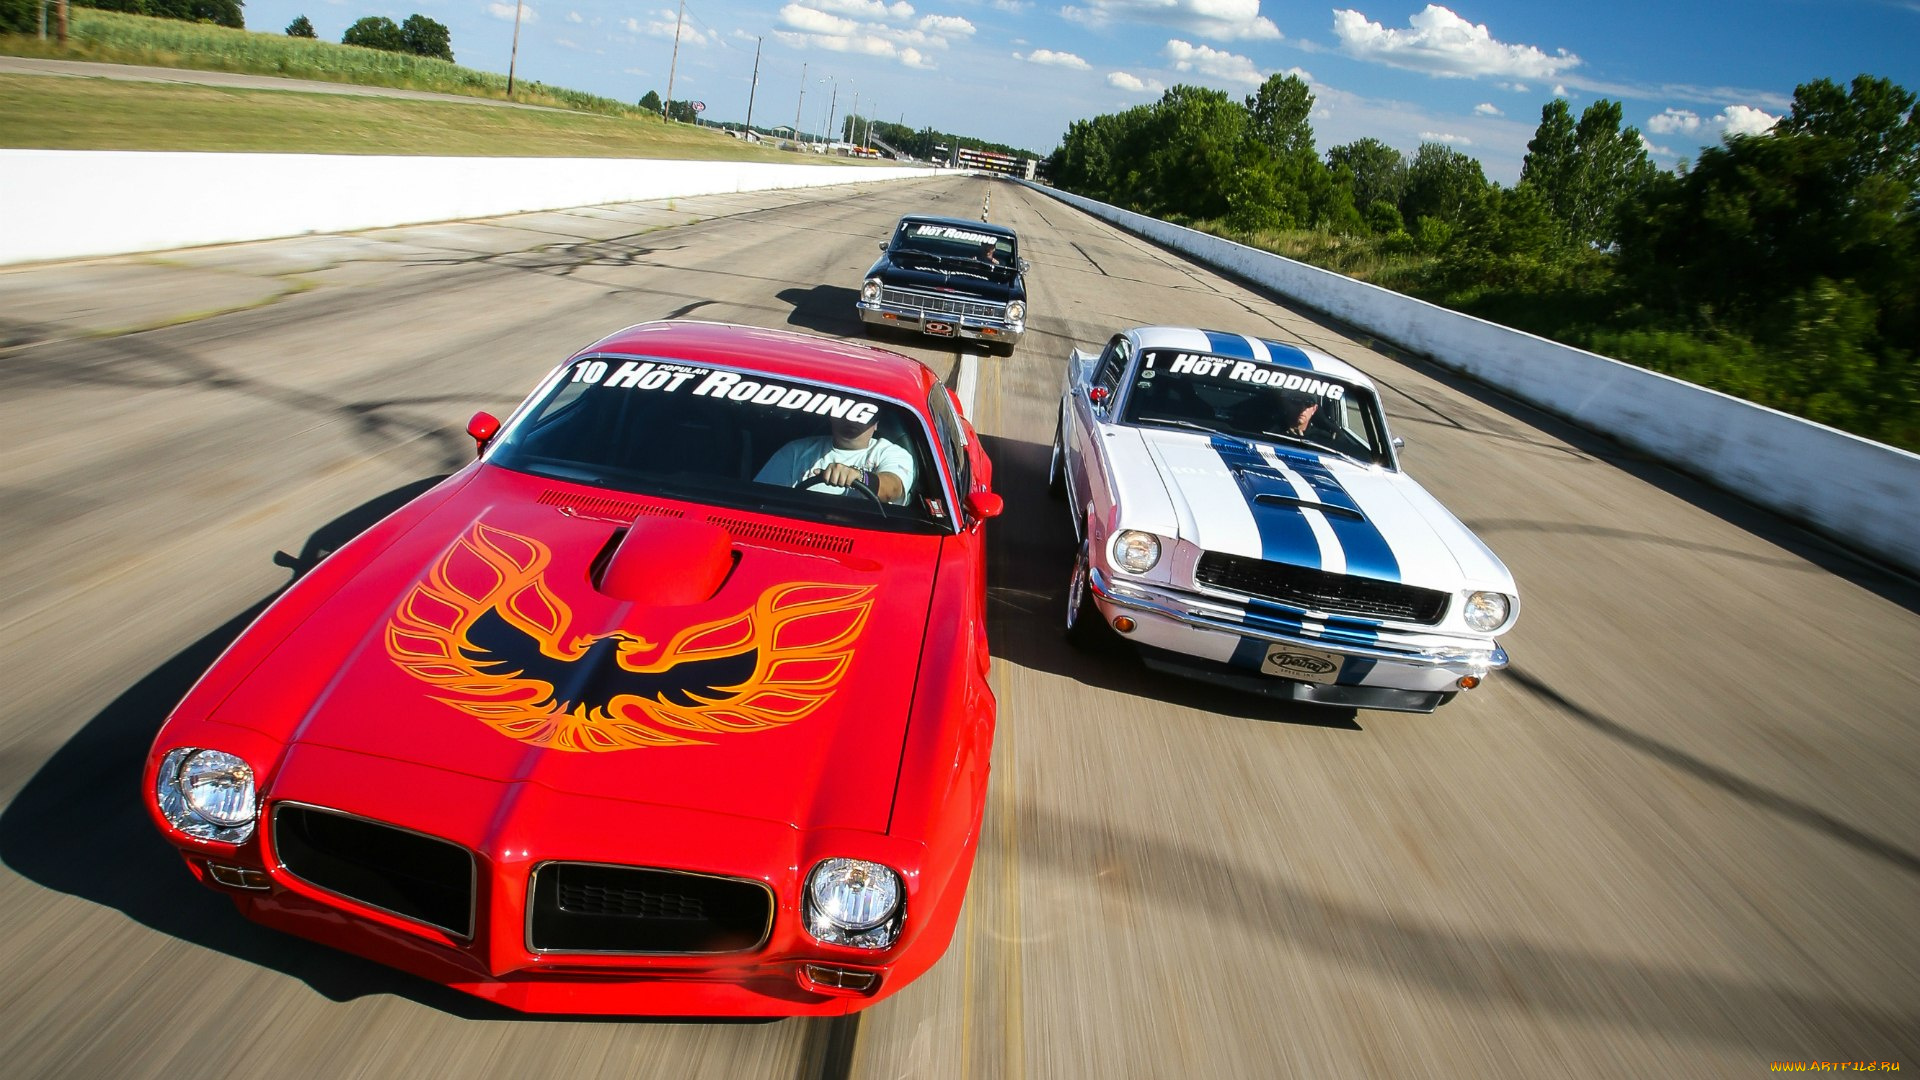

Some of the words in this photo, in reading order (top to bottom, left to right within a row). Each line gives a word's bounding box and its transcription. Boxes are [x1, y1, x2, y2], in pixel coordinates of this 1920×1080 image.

[917, 225, 943, 237] HOT
[943, 227, 998, 245] RODDING
[656, 364, 710, 376] POPULAR
[1145, 352, 1157, 369] 1
[571, 360, 608, 384] 10
[1169, 353, 1228, 377] HOT
[1228, 360, 1345, 401] RODDING
[602, 361, 696, 392] HOT
[692, 370, 880, 425] RODDING
